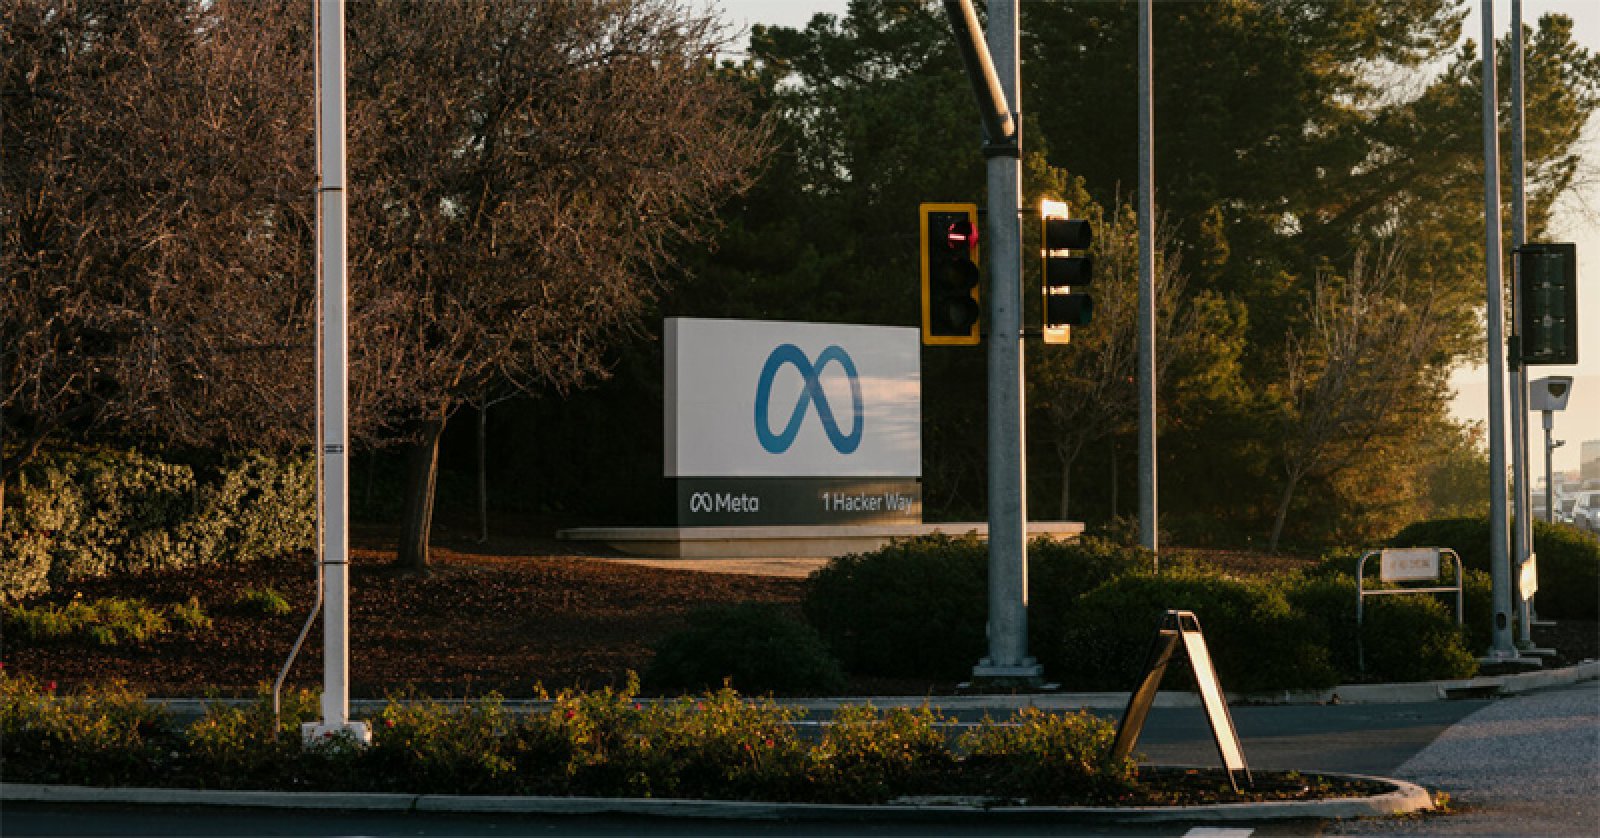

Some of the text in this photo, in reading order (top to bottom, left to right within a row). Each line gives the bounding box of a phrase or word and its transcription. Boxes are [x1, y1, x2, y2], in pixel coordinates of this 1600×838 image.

[715, 493, 759, 512] Meta
[822, 492, 913, 515] 1 Hacker Way
